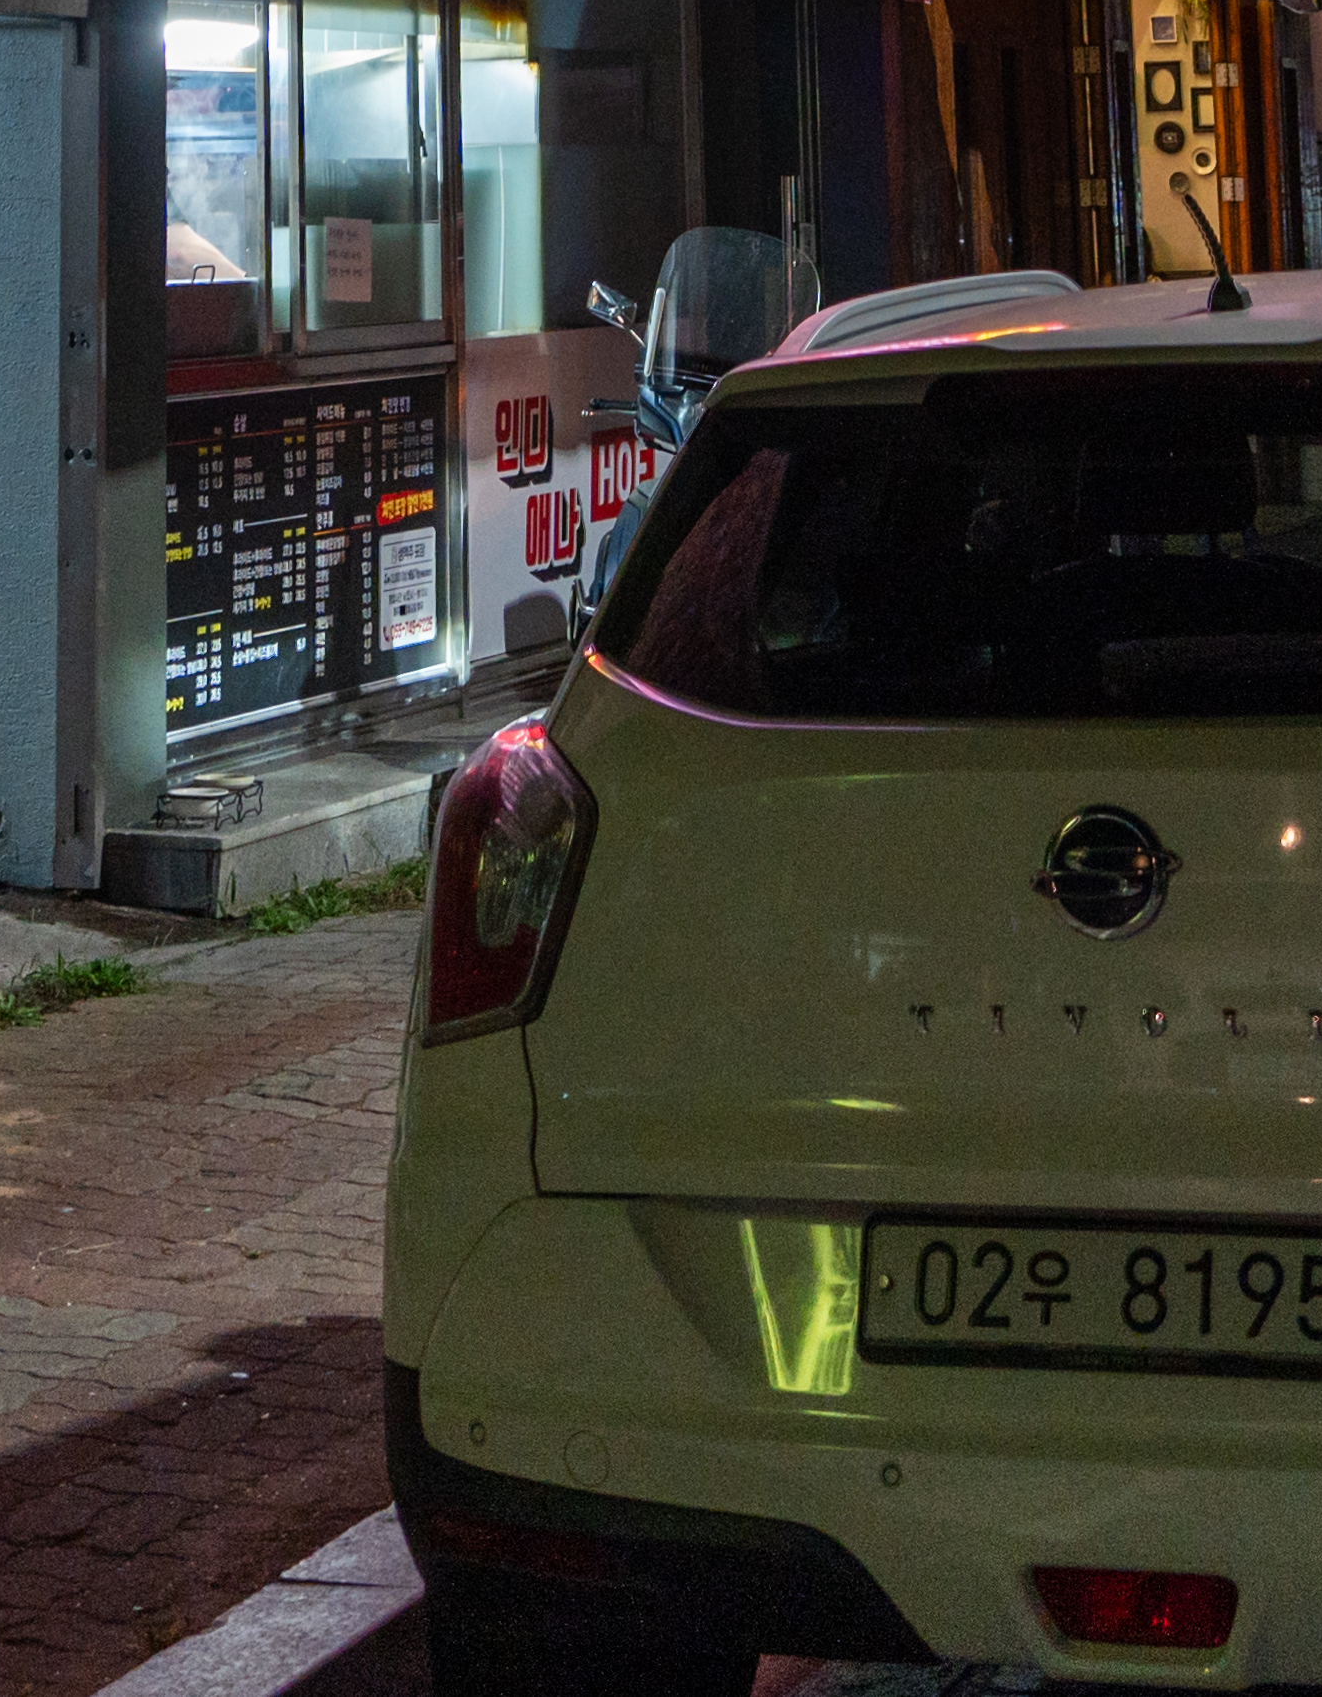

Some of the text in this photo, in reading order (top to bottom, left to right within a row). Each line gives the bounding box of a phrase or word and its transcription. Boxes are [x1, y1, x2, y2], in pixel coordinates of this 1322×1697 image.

[495, 395, 548, 473] 인디
[526, 488, 580, 567] 애나
[915, 1240, 1071, 1328] 02우
